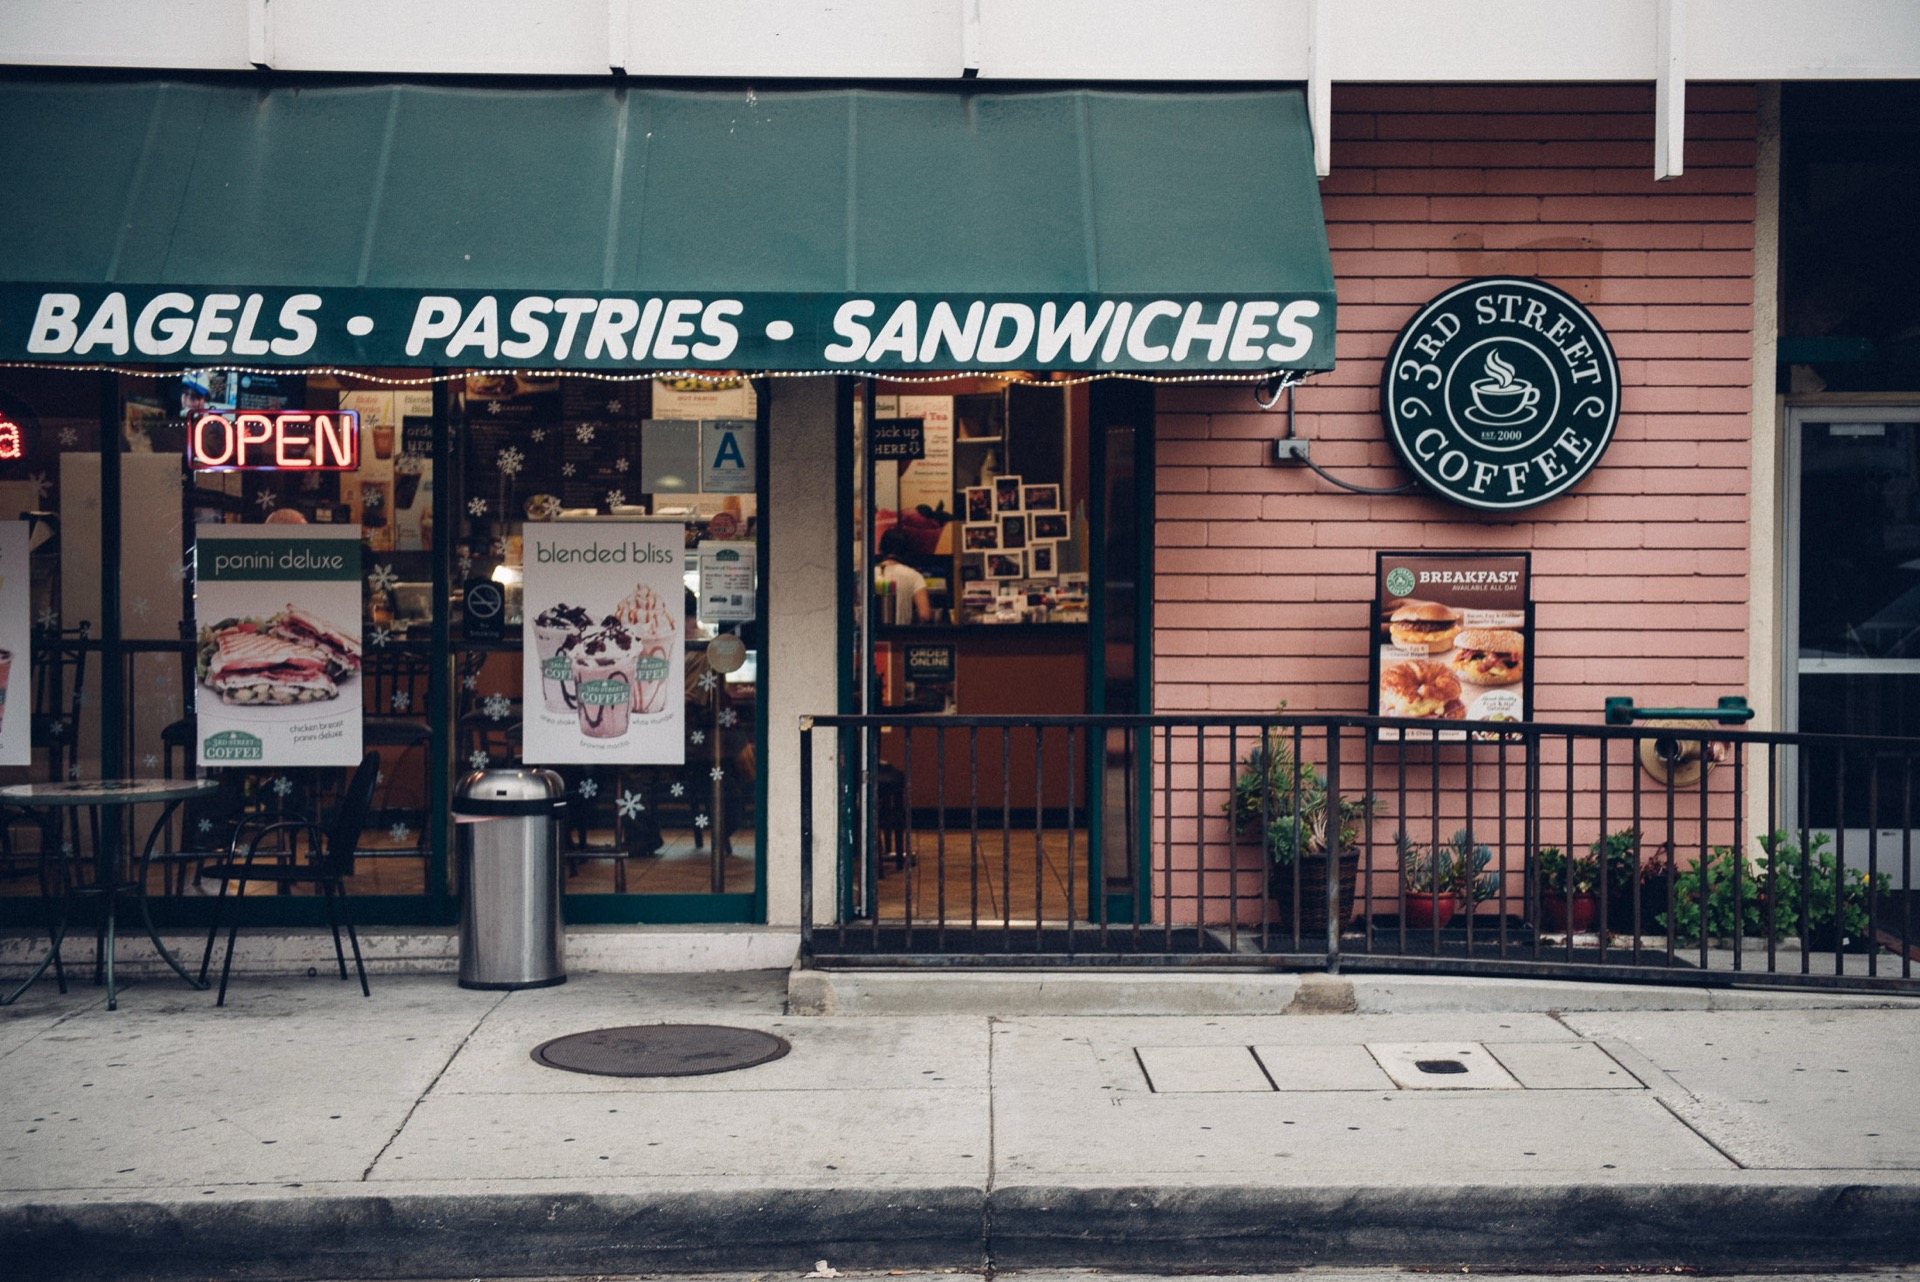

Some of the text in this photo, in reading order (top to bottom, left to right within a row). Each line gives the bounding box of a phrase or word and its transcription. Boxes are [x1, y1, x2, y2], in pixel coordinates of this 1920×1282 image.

[28, 293, 1321, 364] BAGELS PASTRIES SANDWICHES
[1399, 294, 1602, 390] 3RD STREET
[194, 414, 351, 467] OPEN
[903, 429, 919, 439] up
[1497, 430, 1522, 441] 2000
[712, 432, 745, 468] A
[1415, 427, 1592, 496] COFFEE
[536, 541, 673, 563] blended bliss
[215, 549, 343, 575] panini deluxe
[1419, 571, 1520, 584] BREAKFAST
[910, 648, 949, 657] ORDER
[910, 657, 949, 667] ONLINE
[581, 692, 629, 703] COFFEE
[289, 720, 344, 733] chicken breast
[293, 730, 343, 744] panini deluxe
[206, 747, 261, 758] COFFEE
